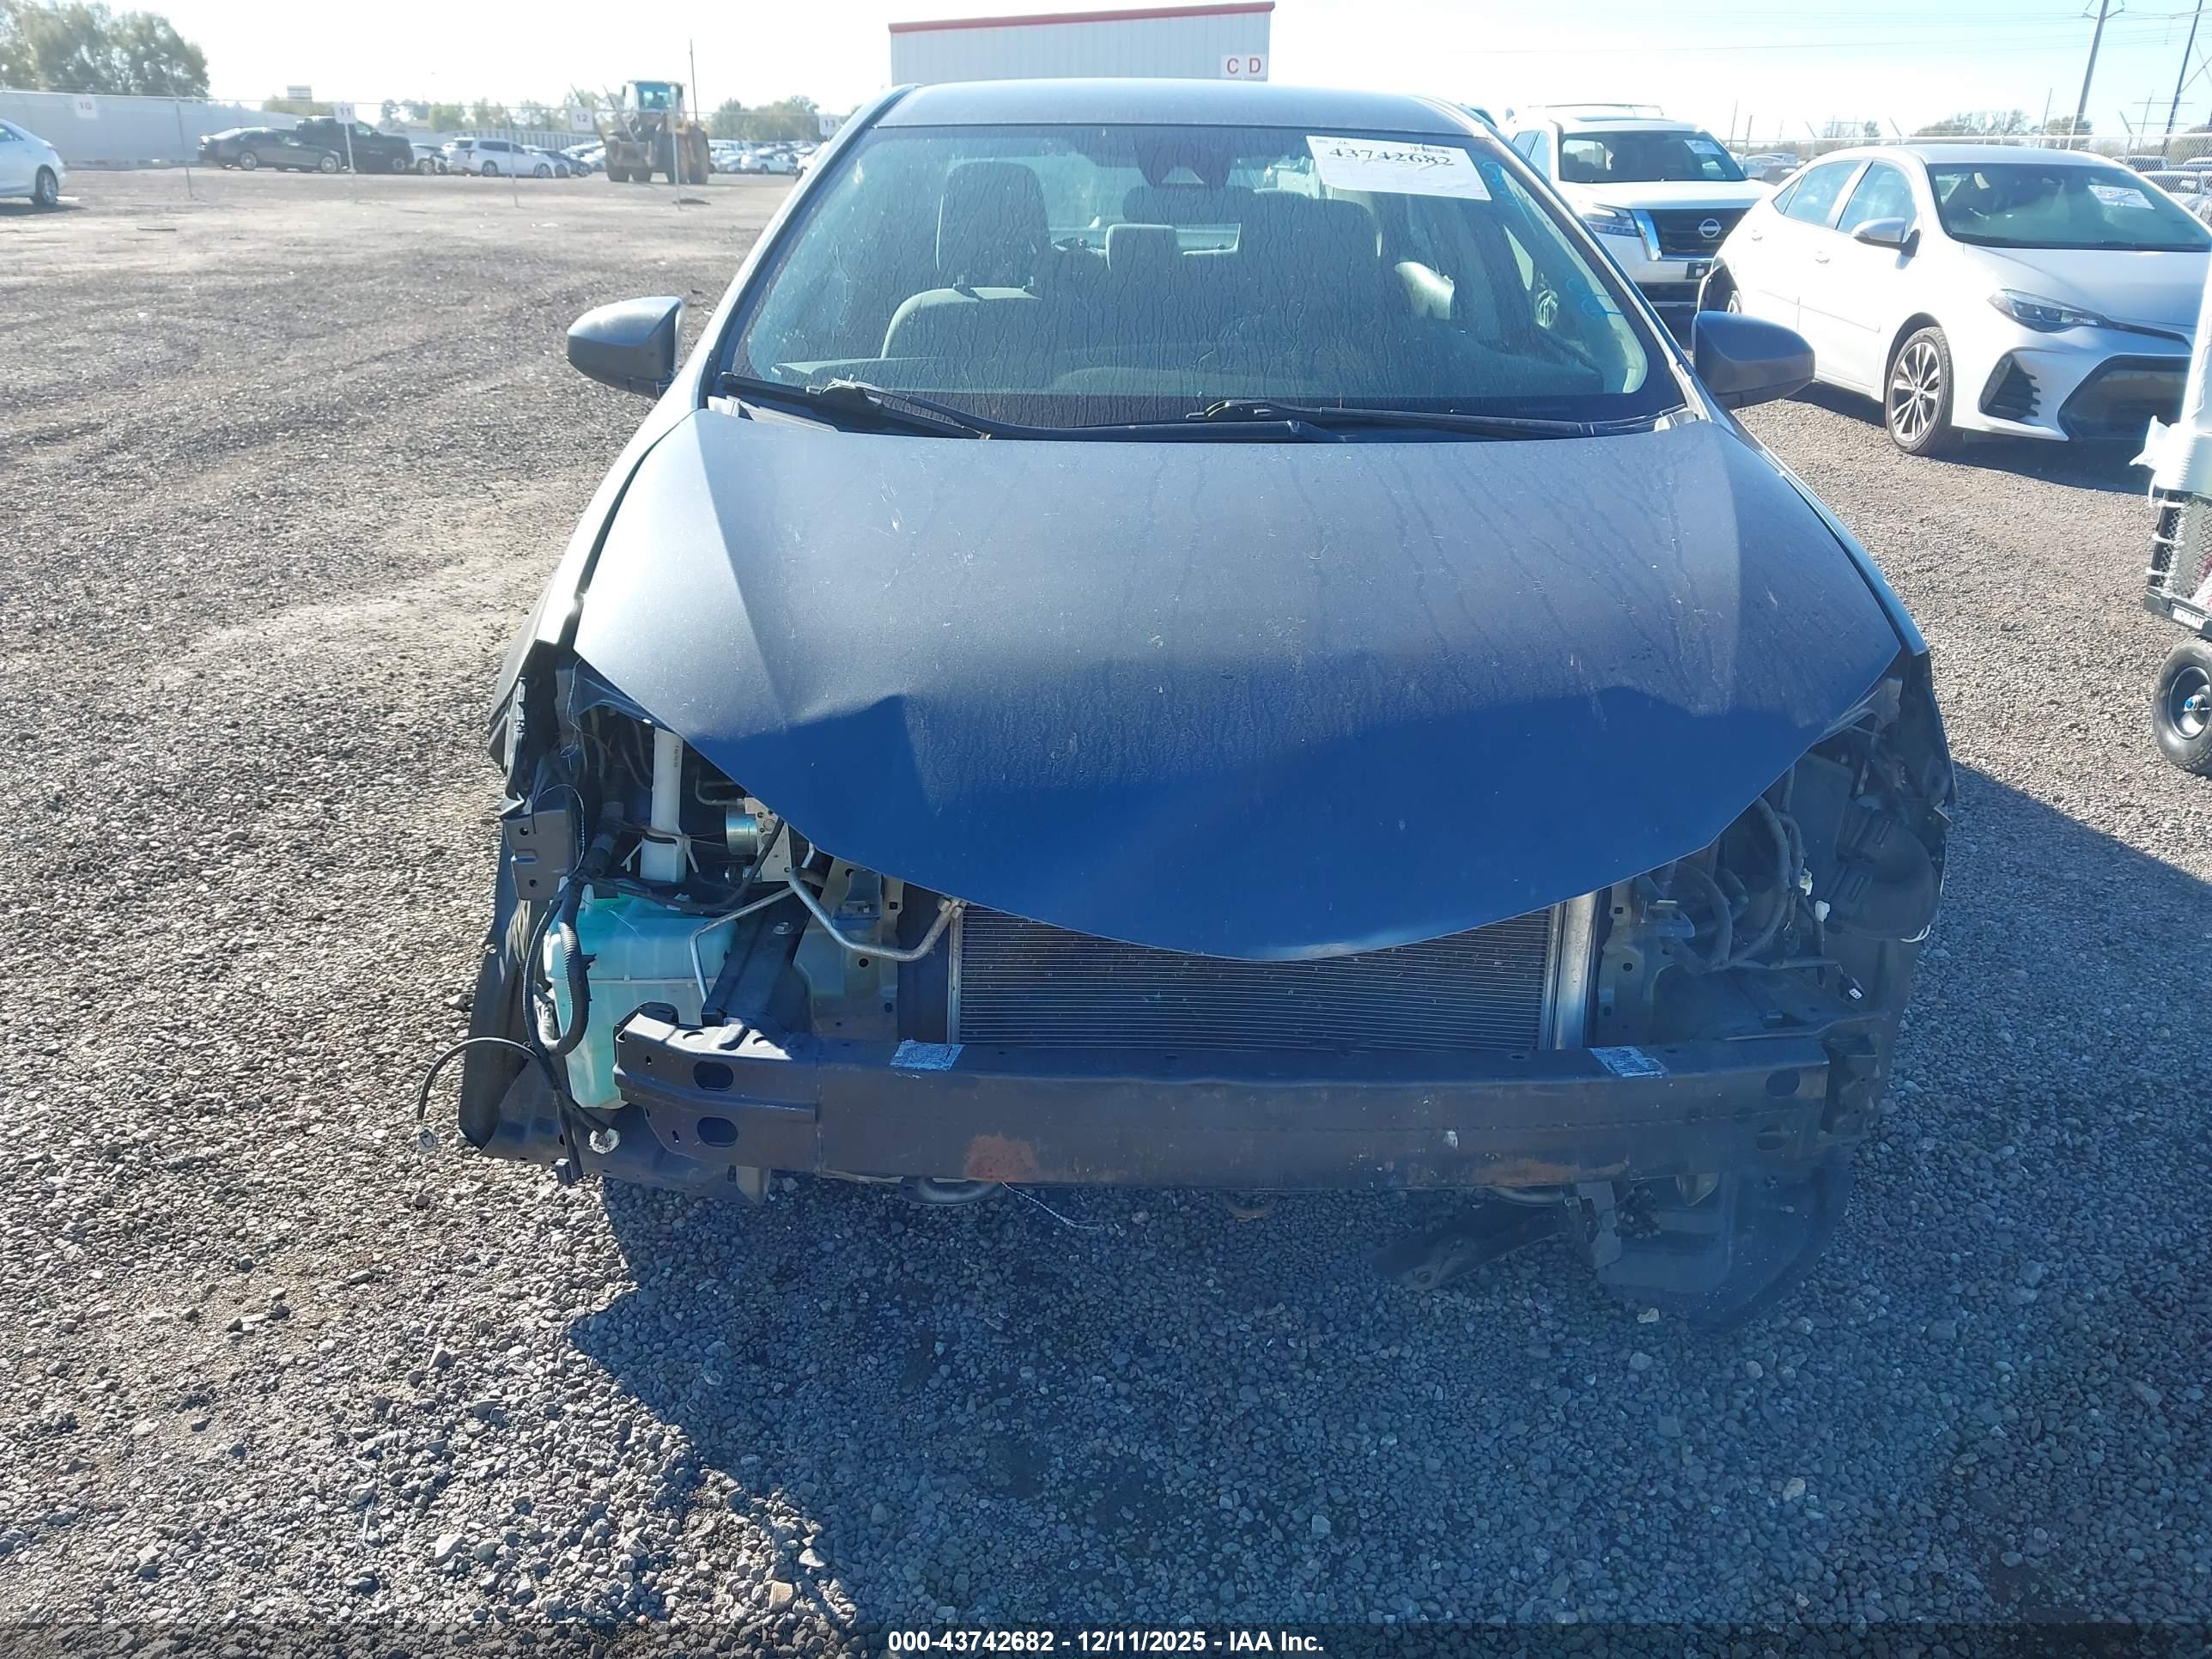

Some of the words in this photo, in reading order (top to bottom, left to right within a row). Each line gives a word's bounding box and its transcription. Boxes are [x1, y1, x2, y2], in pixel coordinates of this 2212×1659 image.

[1226, 58, 1239, 75] C
[1249, 58, 1261, 74] D
[339, 107, 351, 116] 11
[576, 113, 588, 123] 12
[824, 119, 836, 128] 13
[1328, 148, 1455, 166] 43742682
